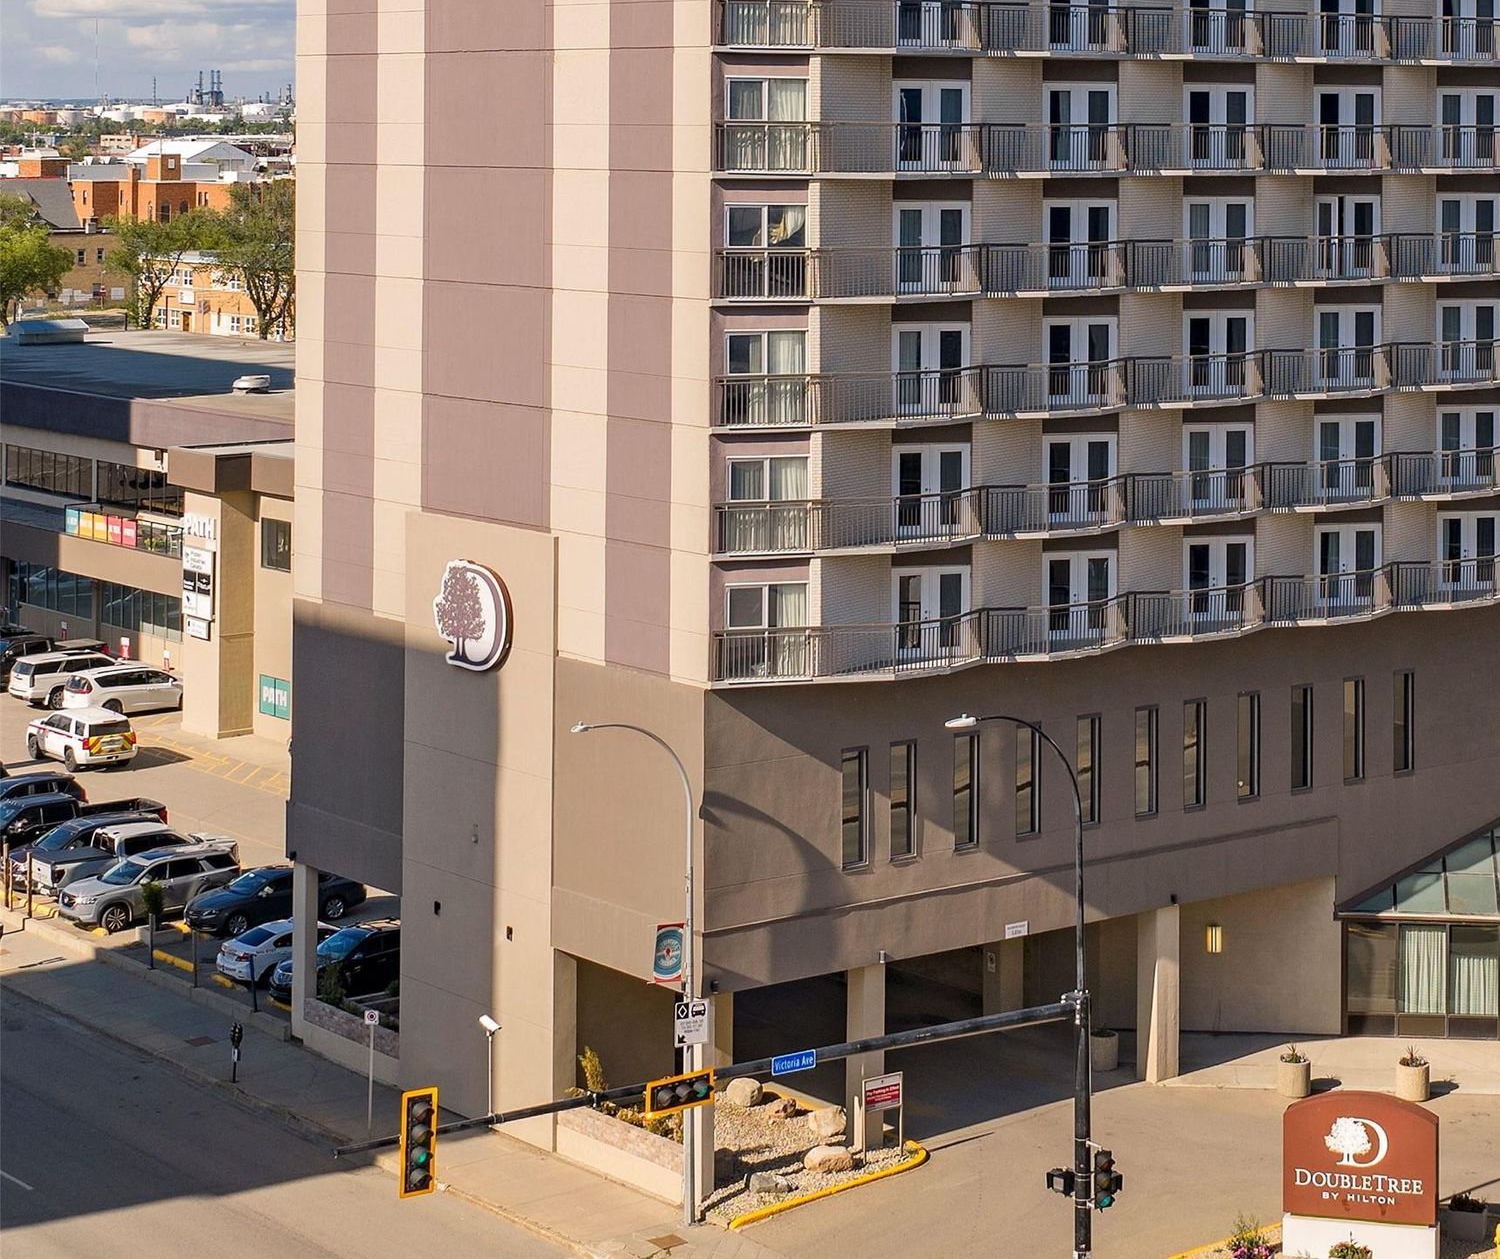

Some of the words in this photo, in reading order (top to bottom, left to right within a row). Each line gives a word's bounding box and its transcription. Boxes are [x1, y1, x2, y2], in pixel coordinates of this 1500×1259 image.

[262, 685, 288, 708] PATH
[775, 1057, 800, 1071] Victoria
[801, 1055, 814, 1066] Ave
[1322, 1191, 1339, 1200] BY
[1347, 1193, 1395, 1205] HILTON
